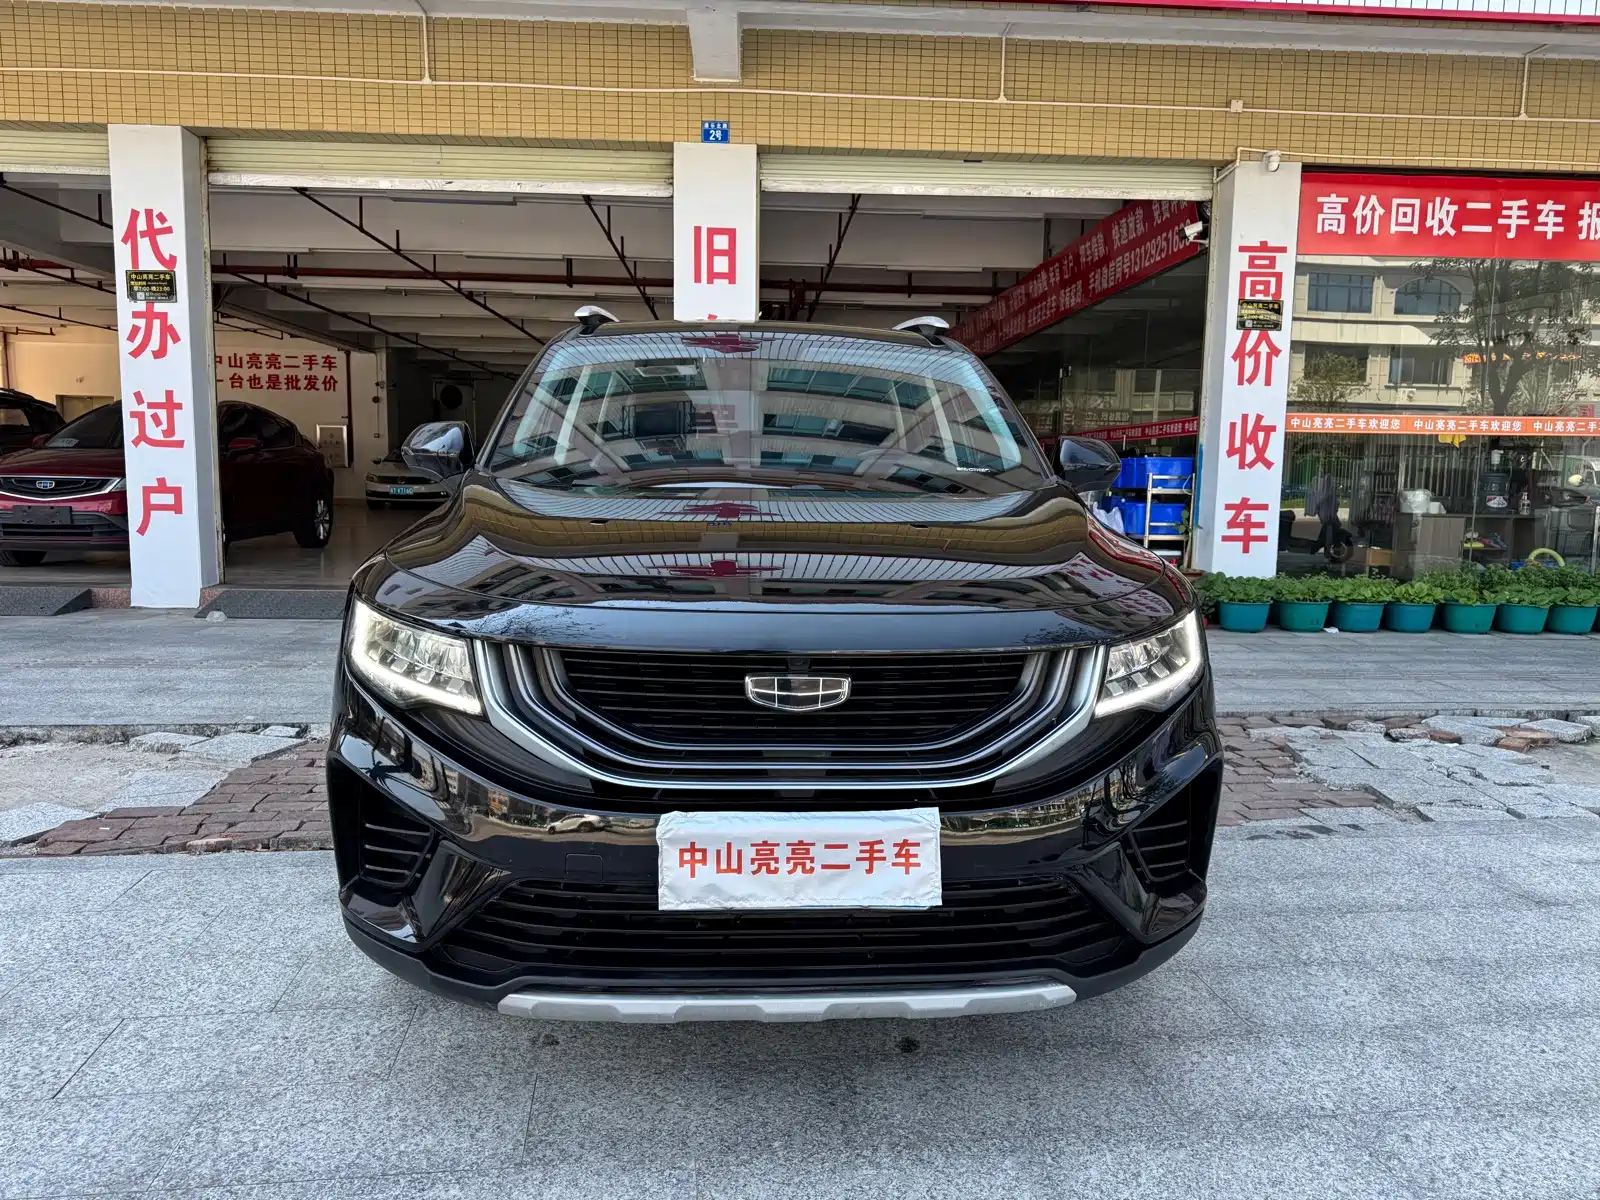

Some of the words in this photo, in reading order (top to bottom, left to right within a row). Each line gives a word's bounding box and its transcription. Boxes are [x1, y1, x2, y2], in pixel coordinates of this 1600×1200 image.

[709, 130, 722, 141] 2号
[1316, 193, 1566, 240] 高价回收二手车
[130, 273, 171, 281] 中山亮亮二手车
[121, 208, 185, 537] 代办过户
[1221, 241, 1288, 554] 高价收车
[1290, 416, 1401, 430] 中山亮亮二手车欢迎您
[1413, 418, 1523, 432] 中山亮亮二手车欢迎您
[1533, 419, 1600, 433] 中山亮亮二手
[678, 839, 922, 879] 中山亮亮二手车
